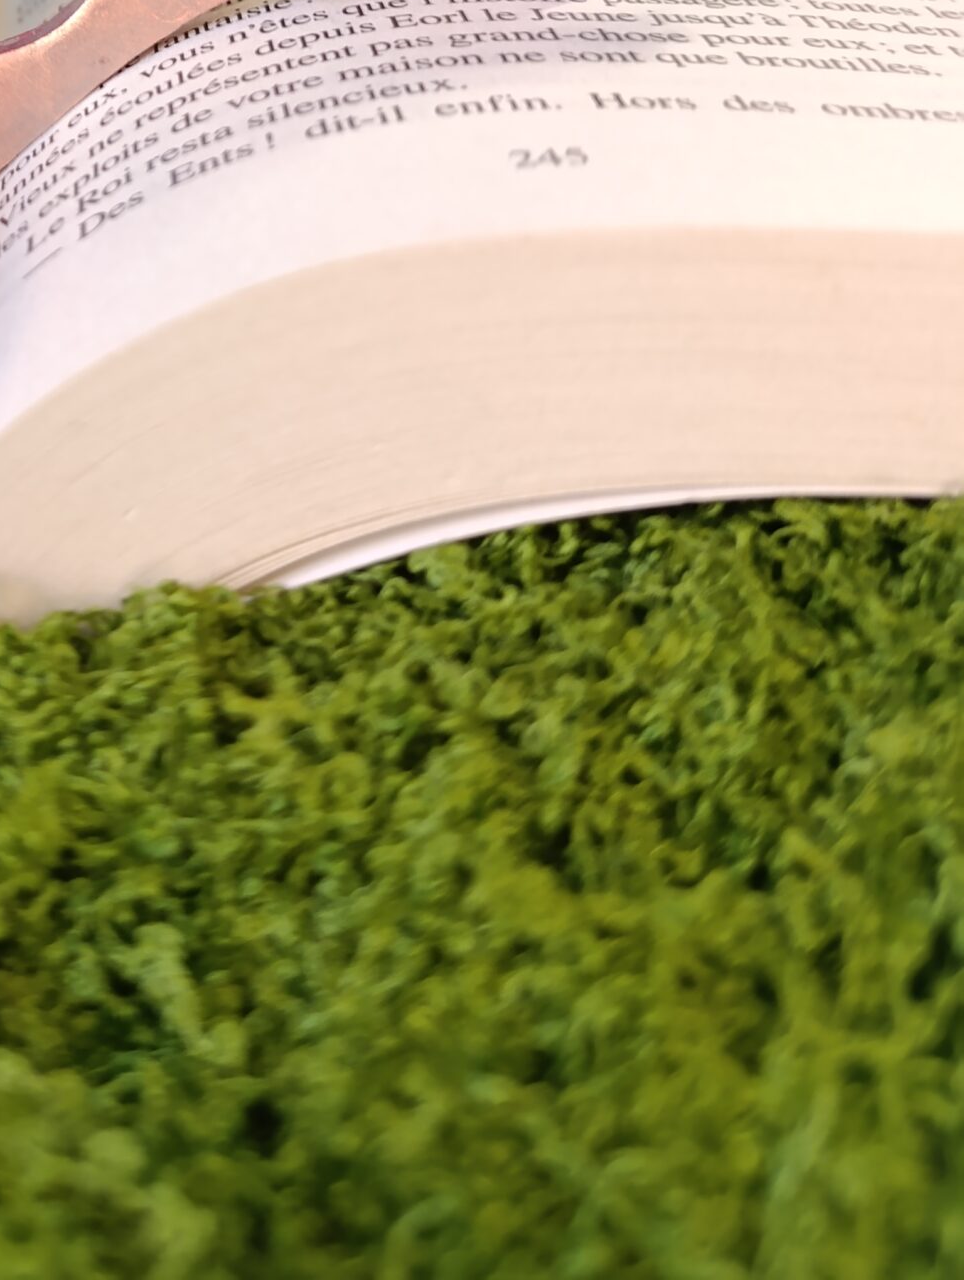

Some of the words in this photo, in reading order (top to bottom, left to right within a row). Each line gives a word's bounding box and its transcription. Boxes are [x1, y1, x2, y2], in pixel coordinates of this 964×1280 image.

[0, 128, 60, 192] pour
[67, 87, 128, 129] eux,
[140, 40, 215, 79] vous
[228, 8, 329, 45] n'êtes
[37, 133, 159, 220] exploits
[170, 107, 214, 135] de
[227, 74, 323, 109] votre
[338, 53, 485, 82] maison
[499, 50, 546, 64] ne
[559, 48, 646, 64] sont
[654, 51, 729, 68] que
[736, 50, 943, 78] broutilles.
[88, 128, 124, 159] ne
[134, 43, 357, 130] représentent
[369, 35, 435, 58] pas
[448, 27, 691, 49] grand-chose
[699, 32, 791, 48] pour
[904, 43, 943, 56] et
[99, 54, 242, 127] écoulées
[254, 21, 377, 57] depuis
[387, 9, 473, 29] Eorl
[483, 8, 518, 22] le
[530, 8, 636, 22] Jeune
[648, 9, 787, 28] jusqu'à
[787, 13, 961, 38] Théoden
[25, 216, 66, 256] Le
[75, 167, 134, 216] Roi
[145, 124, 234, 173] resta
[247, 78, 468, 130] silencieux.
[77, 189, 146, 241] Des
[167, 140, 256, 189] Ents
[305, 104, 406, 138] dit-il
[434, 93, 564, 117] enfin.
[589, 91, 697, 111] Hors
[722, 94, 796, 115] des
[508, 146, 589, 170] 245
